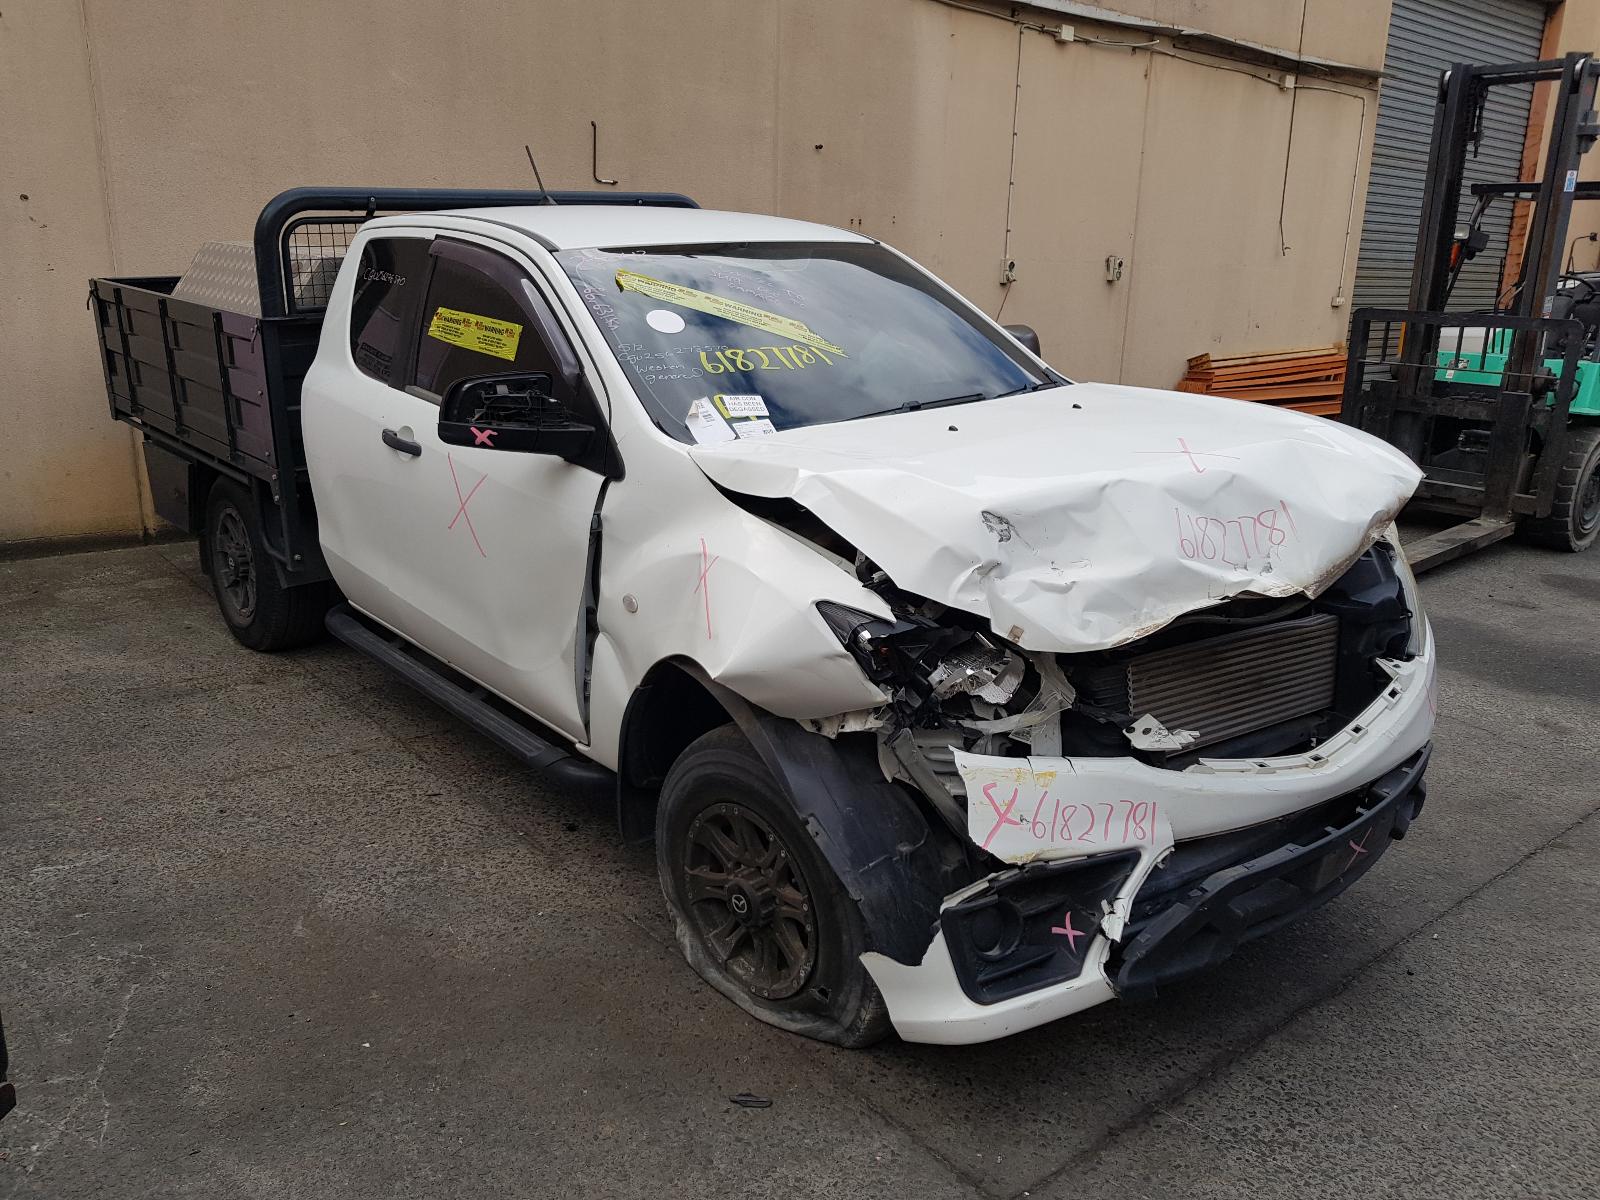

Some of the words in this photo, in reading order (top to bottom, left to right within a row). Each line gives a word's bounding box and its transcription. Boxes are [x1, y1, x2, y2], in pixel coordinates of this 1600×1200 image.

[700, 344, 833, 374] 61827781
[1175, 500, 1300, 567] 61827781
[1031, 790, 1156, 845] 61827781
